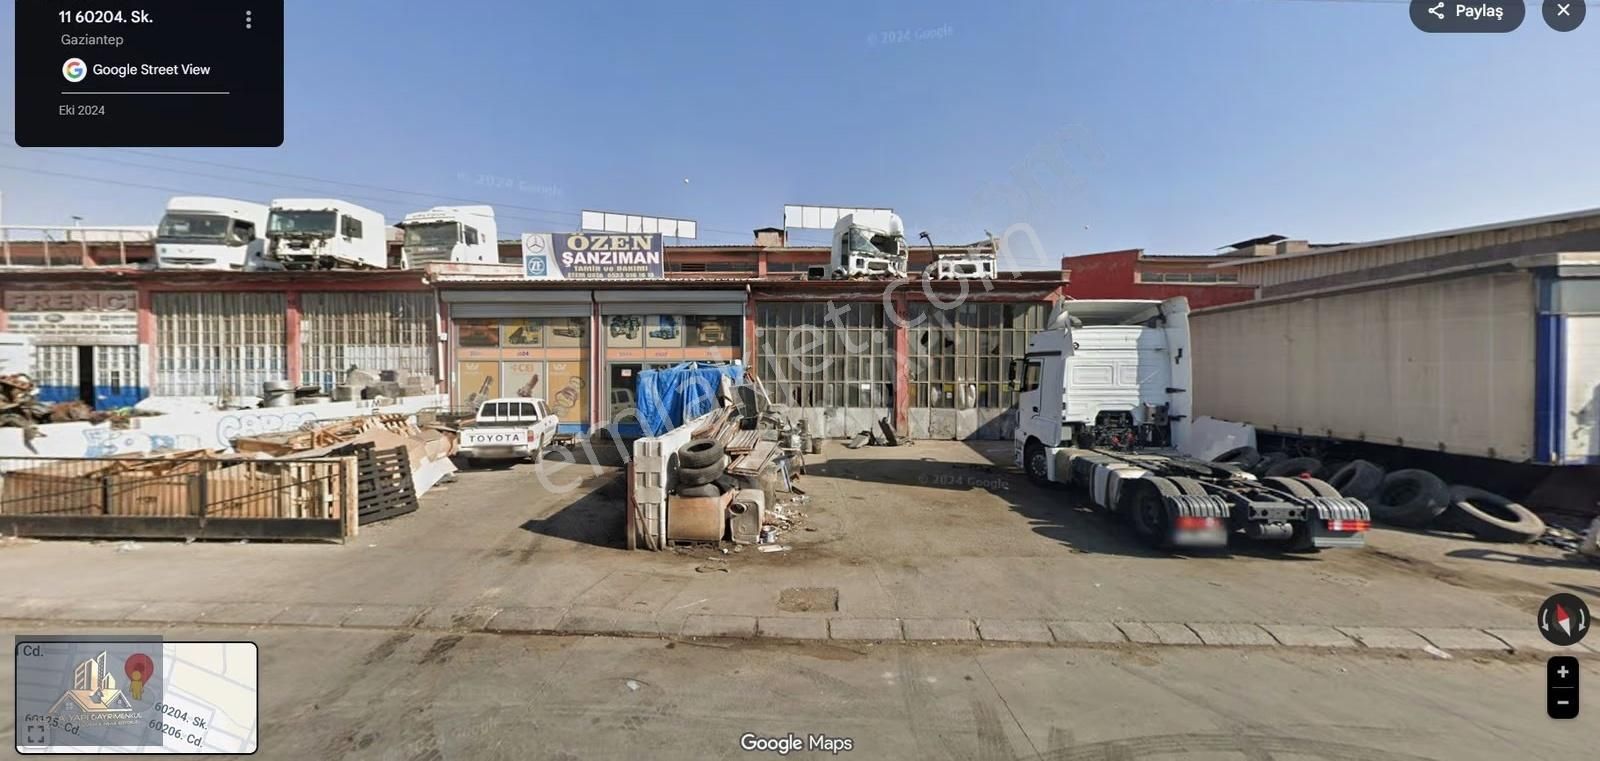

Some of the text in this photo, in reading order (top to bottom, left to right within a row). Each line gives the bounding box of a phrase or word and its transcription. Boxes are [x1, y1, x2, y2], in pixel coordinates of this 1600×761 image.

[567, 233, 654, 251] ÖZEN
[562, 252, 660, 267] ŞANZIMAN
[469, 433, 520, 443] TOYOTA
